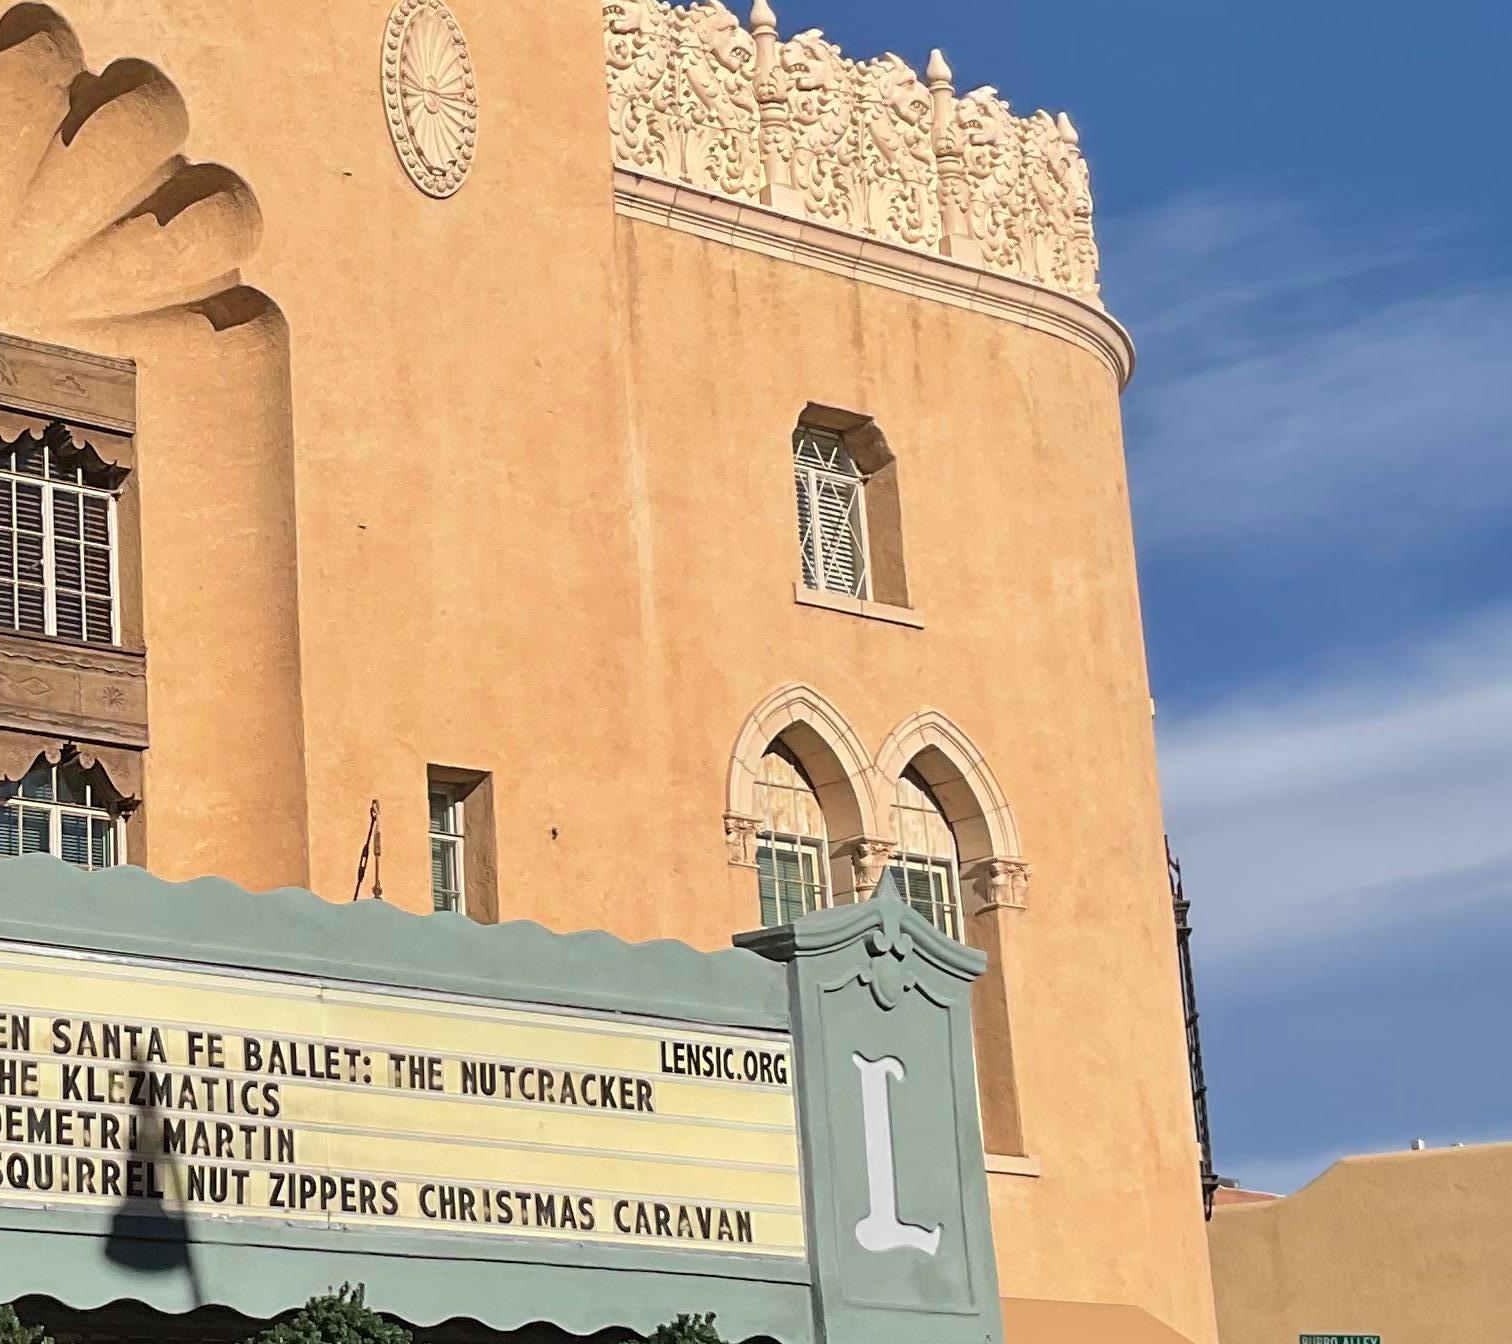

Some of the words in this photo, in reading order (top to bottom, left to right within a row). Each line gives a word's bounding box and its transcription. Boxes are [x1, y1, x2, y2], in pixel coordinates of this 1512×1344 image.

[52, 1017, 167, 1064] SANTA
[187, 1031, 224, 1069] FE
[244, 1037, 372, 1084] BALLET:
[389, 1053, 444, 1093] THE
[461, 1060, 654, 1113] NUTCRACKER
[661, 1041, 788, 1084] LENSIC.ORG
[62, 1064, 280, 1118] KLEZMATICS
[163, 1118, 295, 1164] MARTIN
[187, 1164, 249, 1206] NUT
[268, 1172, 398, 1216] ZIPPERS
[419, 1183, 595, 1231] CHRISTMAS
[613, 1199, 752, 1243] CARAVAN
